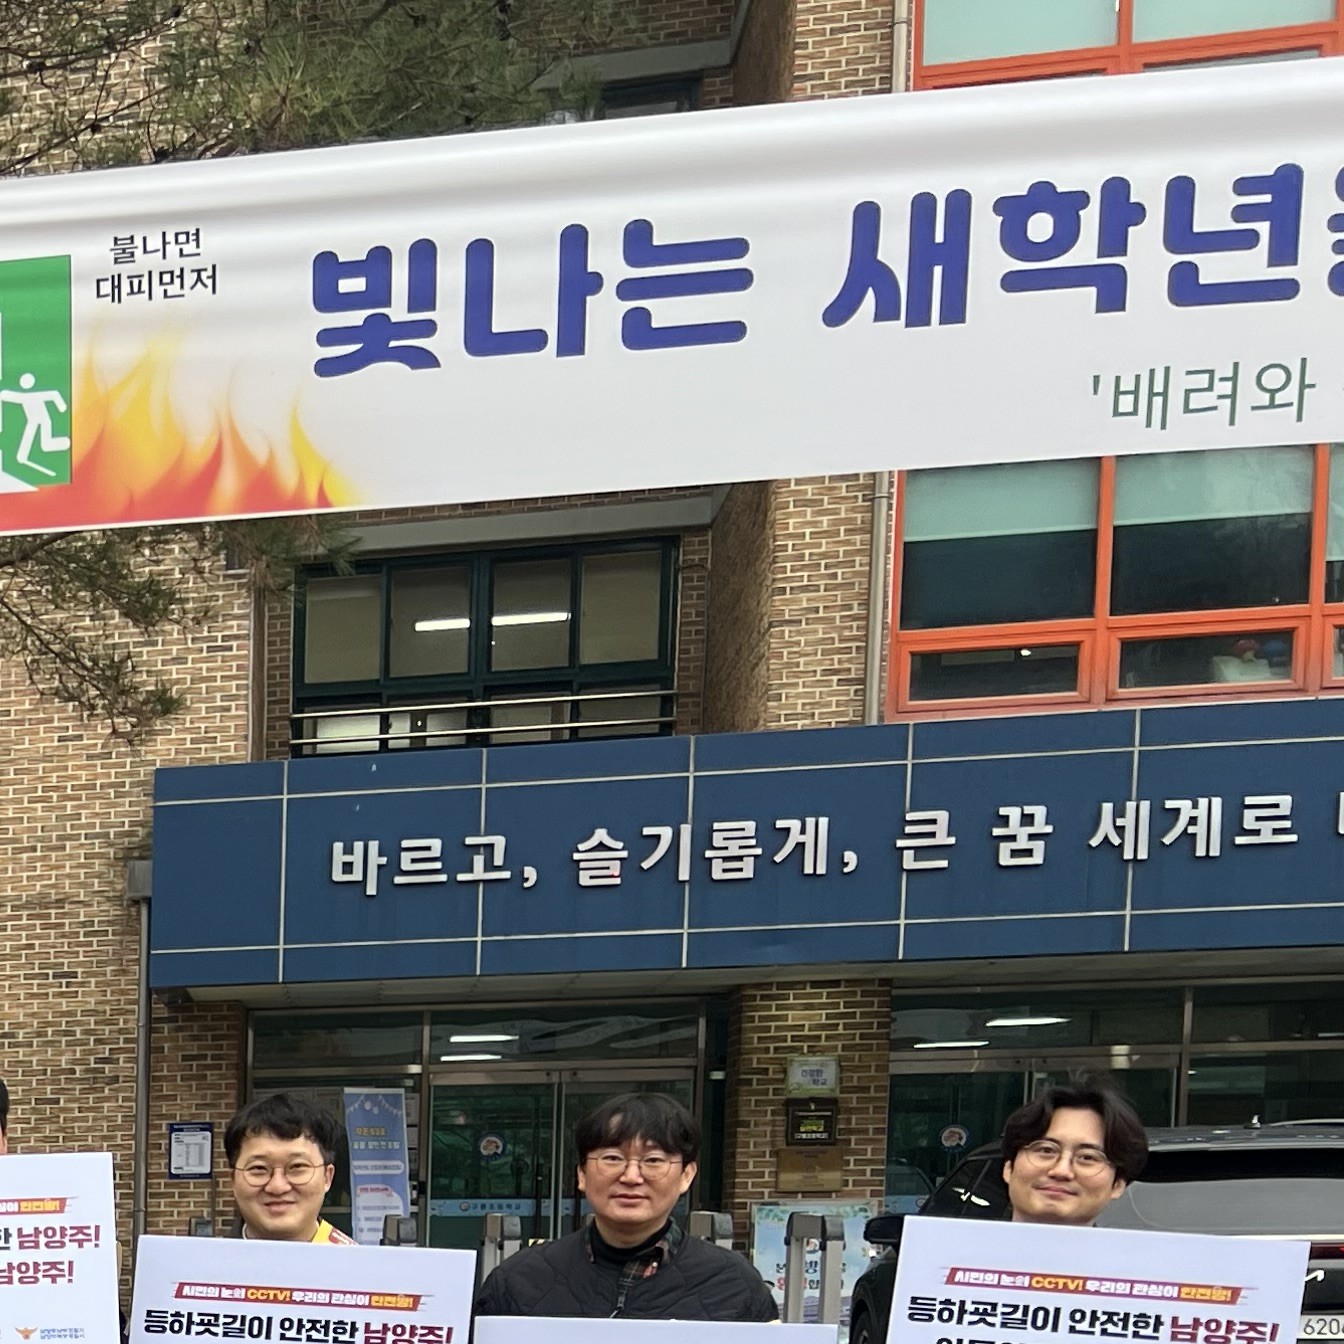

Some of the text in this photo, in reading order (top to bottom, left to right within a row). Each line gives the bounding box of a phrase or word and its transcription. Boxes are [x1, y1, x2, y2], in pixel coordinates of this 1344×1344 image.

[109, 229, 202, 265] 불나면
[96, 263, 219, 306] 대피먼저
[312, 160, 1344, 379] 빛나는 새학년
[1093, 357, 1317, 431] '배려와
[330, 795, 1299, 898] 바르고, 슬기롭게, 큰 꿈 세계로
[16, 1224, 100, 1249] 남양주!
[246, 1288, 290, 1301] CCTV!
[1030, 1275, 1084, 1291] CCTV!
[143, 1308, 273, 1339] 등하굣길이
[278, 1316, 359, 1344] 안전한
[906, 1295, 1062, 1332] 등하굣길이
[1066, 1307, 1165, 1340] 안전한
[1303, 1317, 1344, 1336] 620
